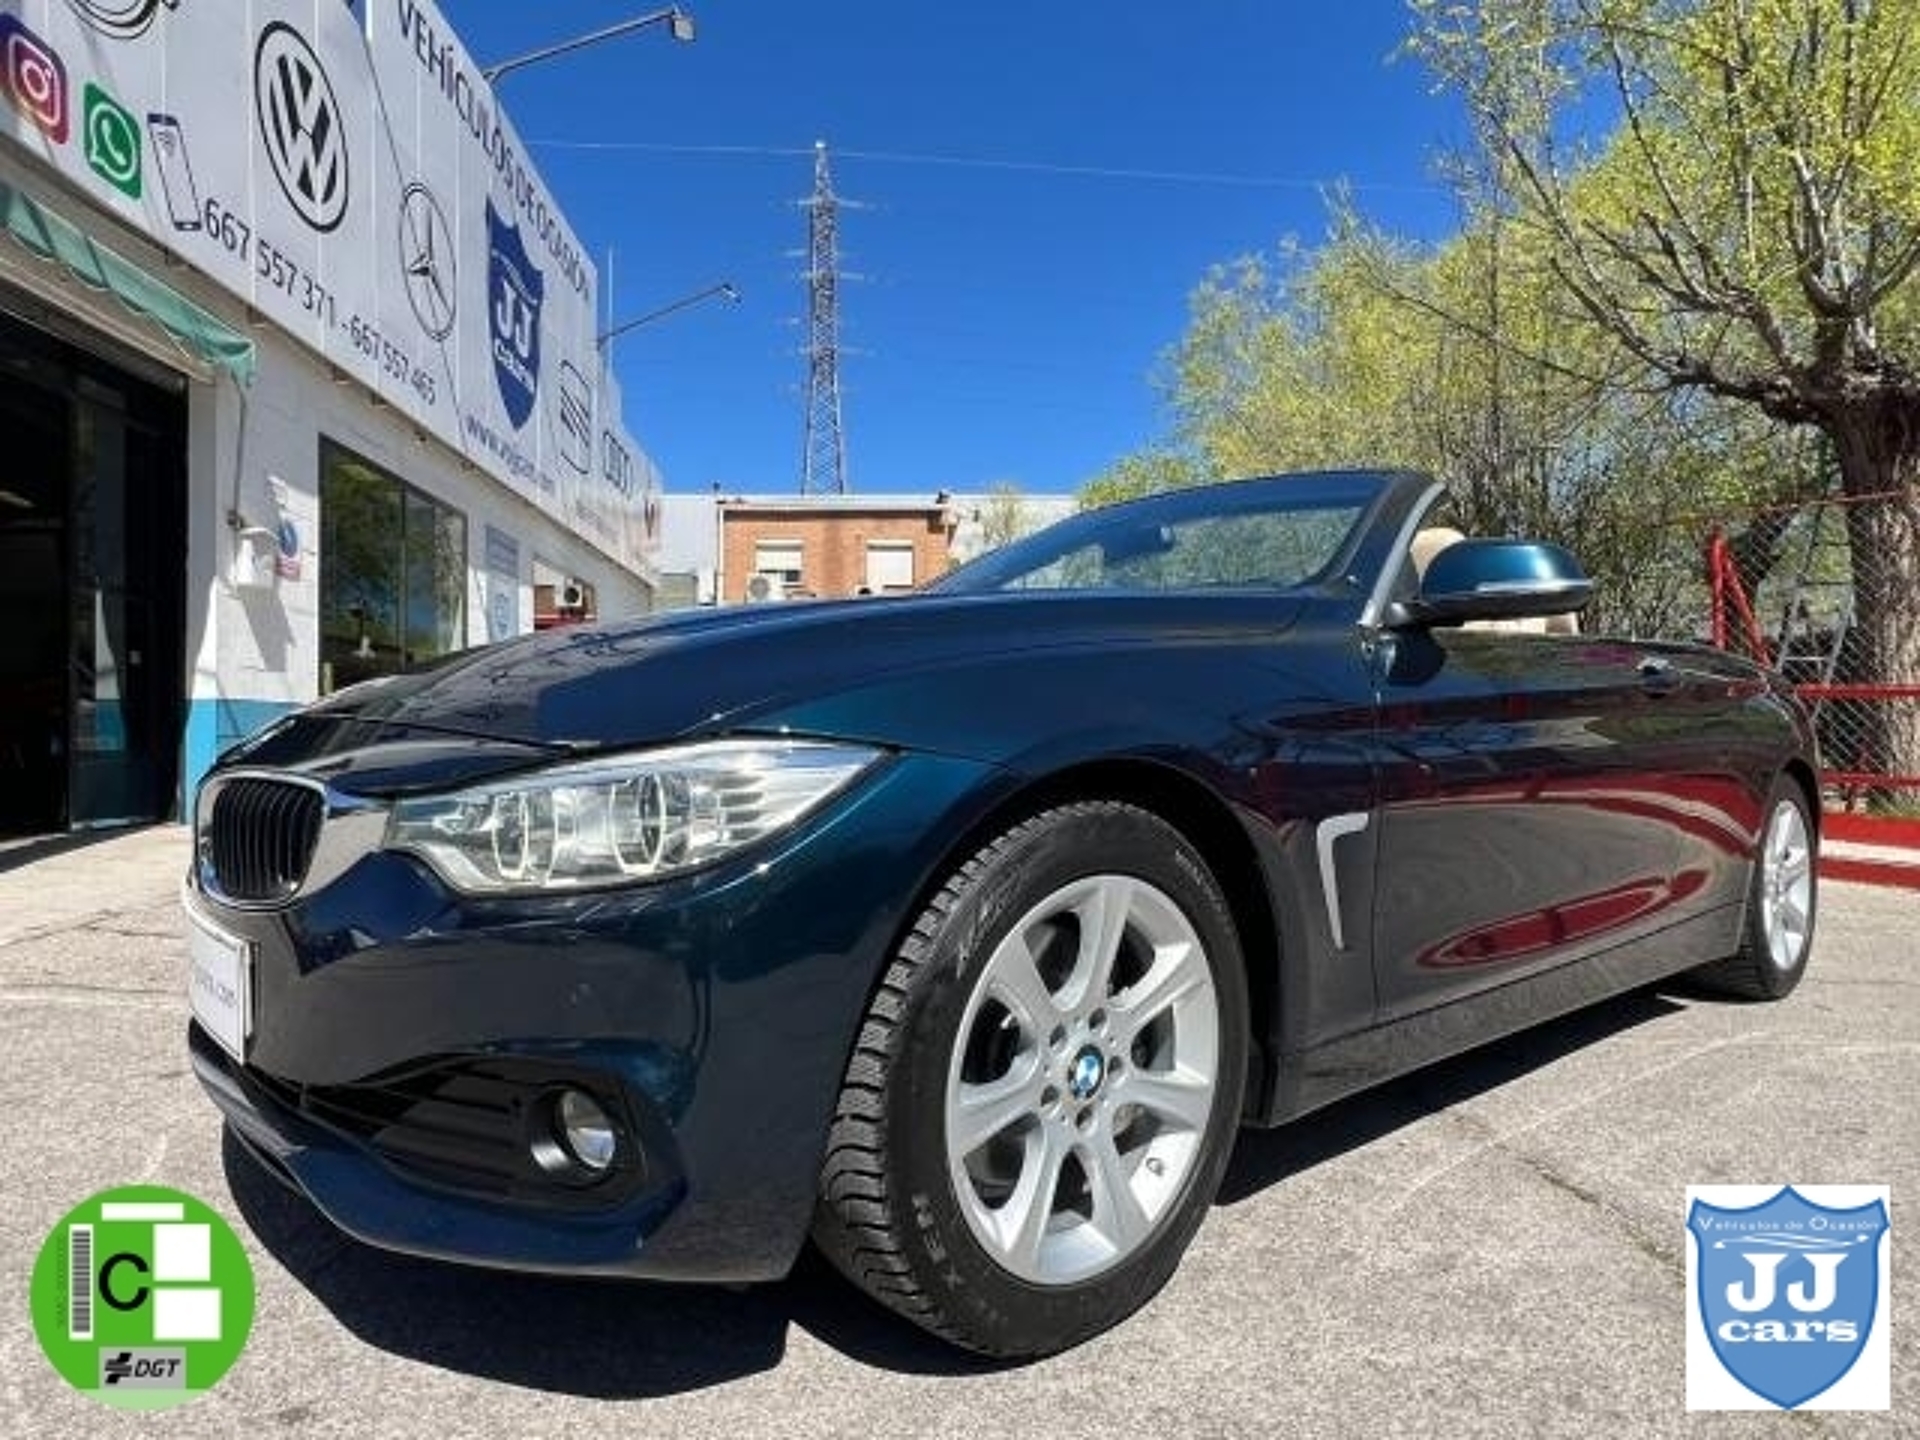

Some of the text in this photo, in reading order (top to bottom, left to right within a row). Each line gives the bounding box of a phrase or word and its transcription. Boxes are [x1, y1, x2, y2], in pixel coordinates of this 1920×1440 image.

[204, 198, 251, 261] 667
[259, 238, 298, 297] 557
[302, 270, 336, 328] 371
[497, 276, 532, 358] JJ
